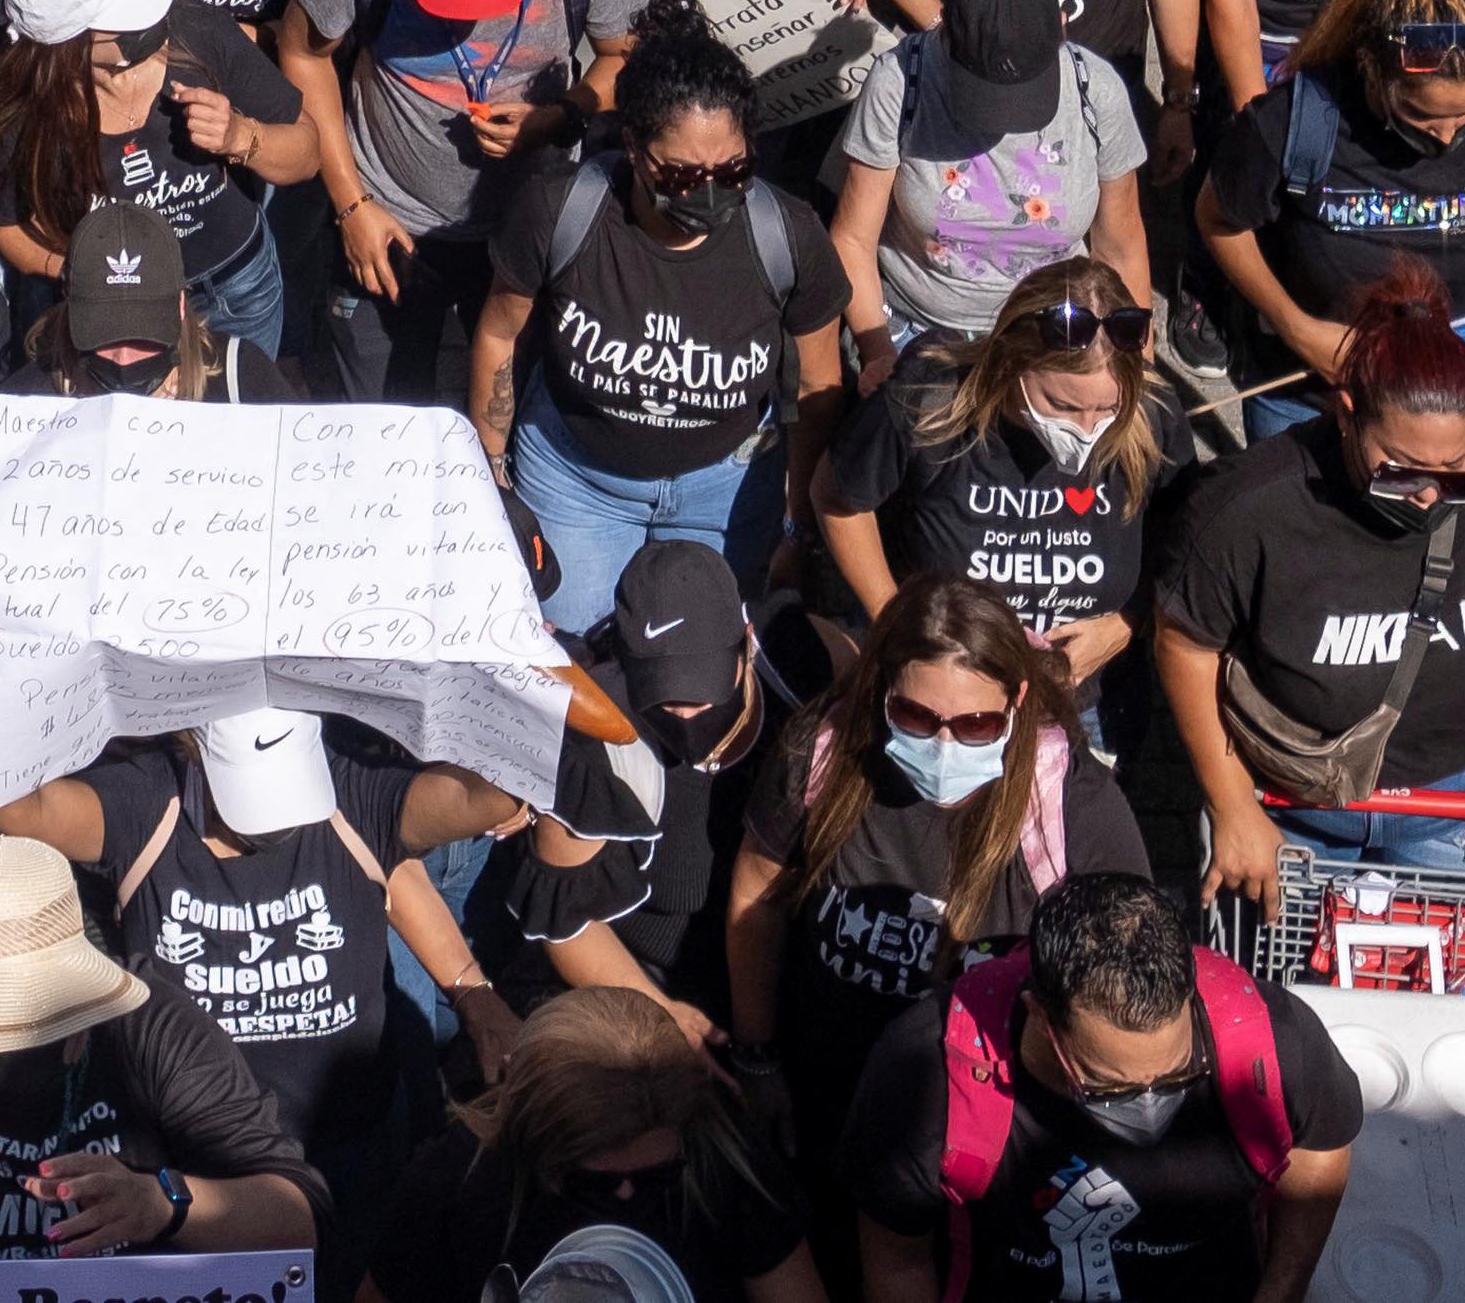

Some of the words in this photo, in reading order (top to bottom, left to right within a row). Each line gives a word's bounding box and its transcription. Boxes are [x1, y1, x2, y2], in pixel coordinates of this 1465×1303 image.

[107, 273, 141, 286] adidas
[645, 313, 680, 340] SIN
[560, 301, 770, 391] Maestros
[594, 365, 631, 394] PAÍS
[129, 417, 184, 437] con
[293, 417, 353, 443] Con
[168, 465, 264, 489] servicio
[151, 513, 183, 536] de
[283, 541, 377, 576] pensión
[407, 533, 507, 557] vitalicia
[969, 551, 1104, 586] SUELDO
[108, 560, 148, 580] con
[178, 554, 210, 581] la
[229, 556, 261, 585] ley
[347, 583, 381, 606] 63
[155, 597, 228, 623] 75%
[333, 620, 417, 648] 95%
[255, 882, 327, 928] retiro
[184, 956, 328, 997] sueldo
[260, 983, 333, 1014] juega
